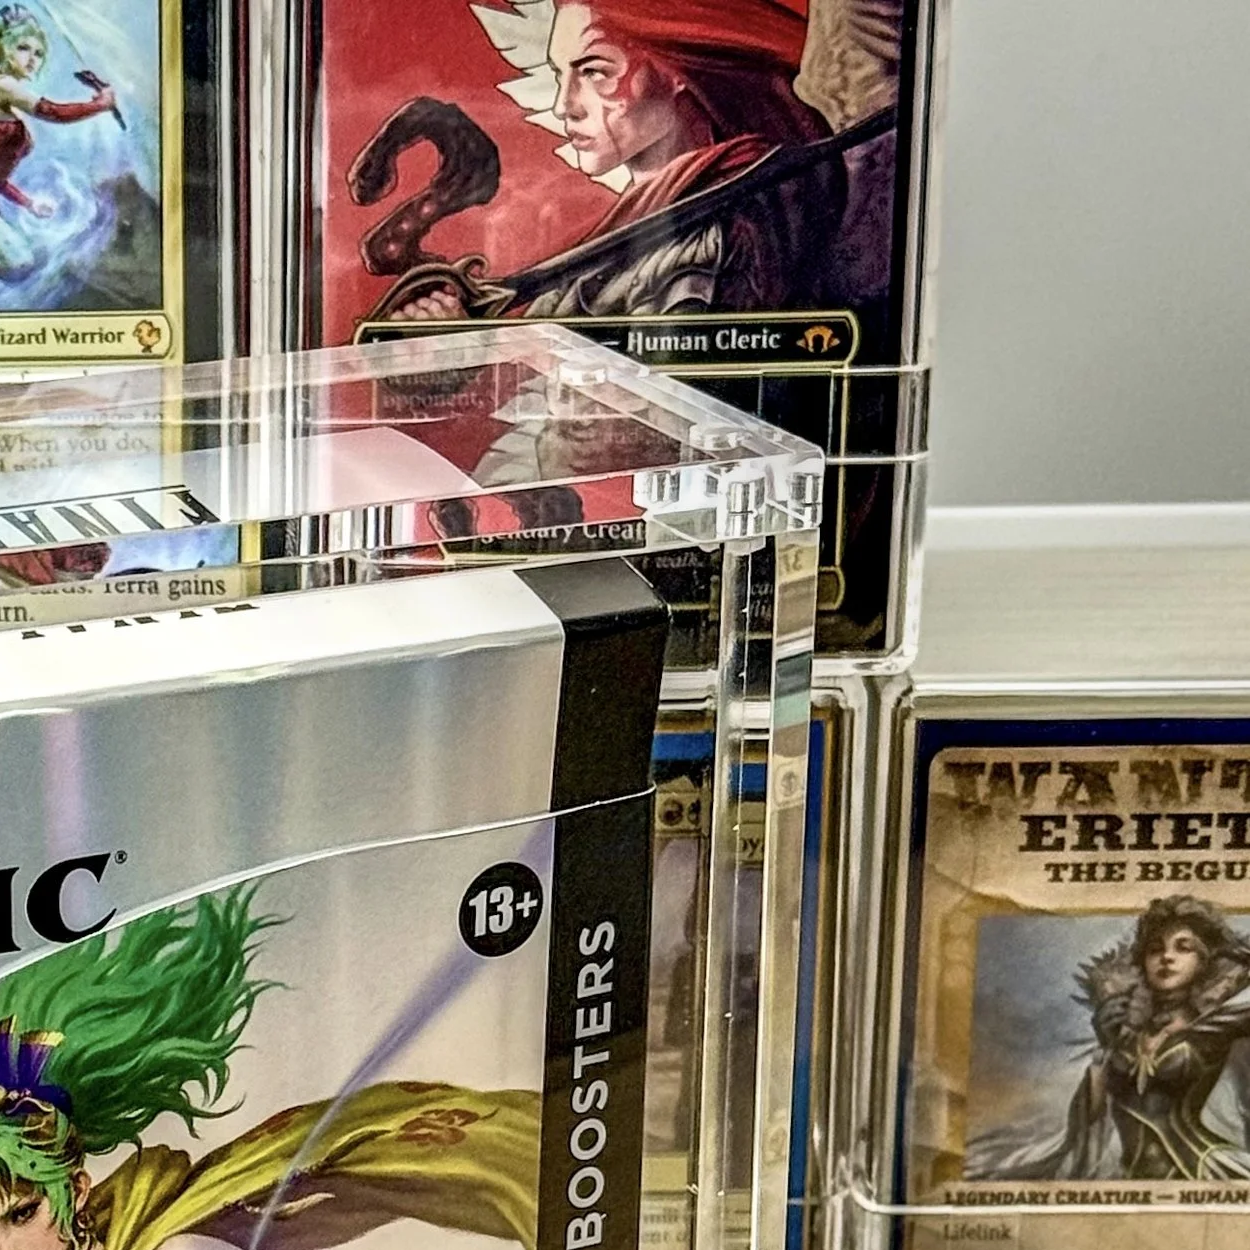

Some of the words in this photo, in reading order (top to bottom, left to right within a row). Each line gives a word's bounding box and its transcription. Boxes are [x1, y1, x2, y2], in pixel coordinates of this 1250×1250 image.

[52, 327, 126, 344] Warrior
[626, 331, 710, 355] Human
[714, 327, 783, 351] Cleric
[66, 437, 108, 455] you
[166, 574, 227, 601] gains
[1044, 861, 1128, 883] THE
[467, 886, 540, 940] 13+
[943, 1189, 1050, 1206] LEGENDARY
[1055, 1189, 1153, 1205] CREATURE
[1179, 1189, 1249, 1205] HUMAN
[943, 1222, 1012, 1241] Lifelink
